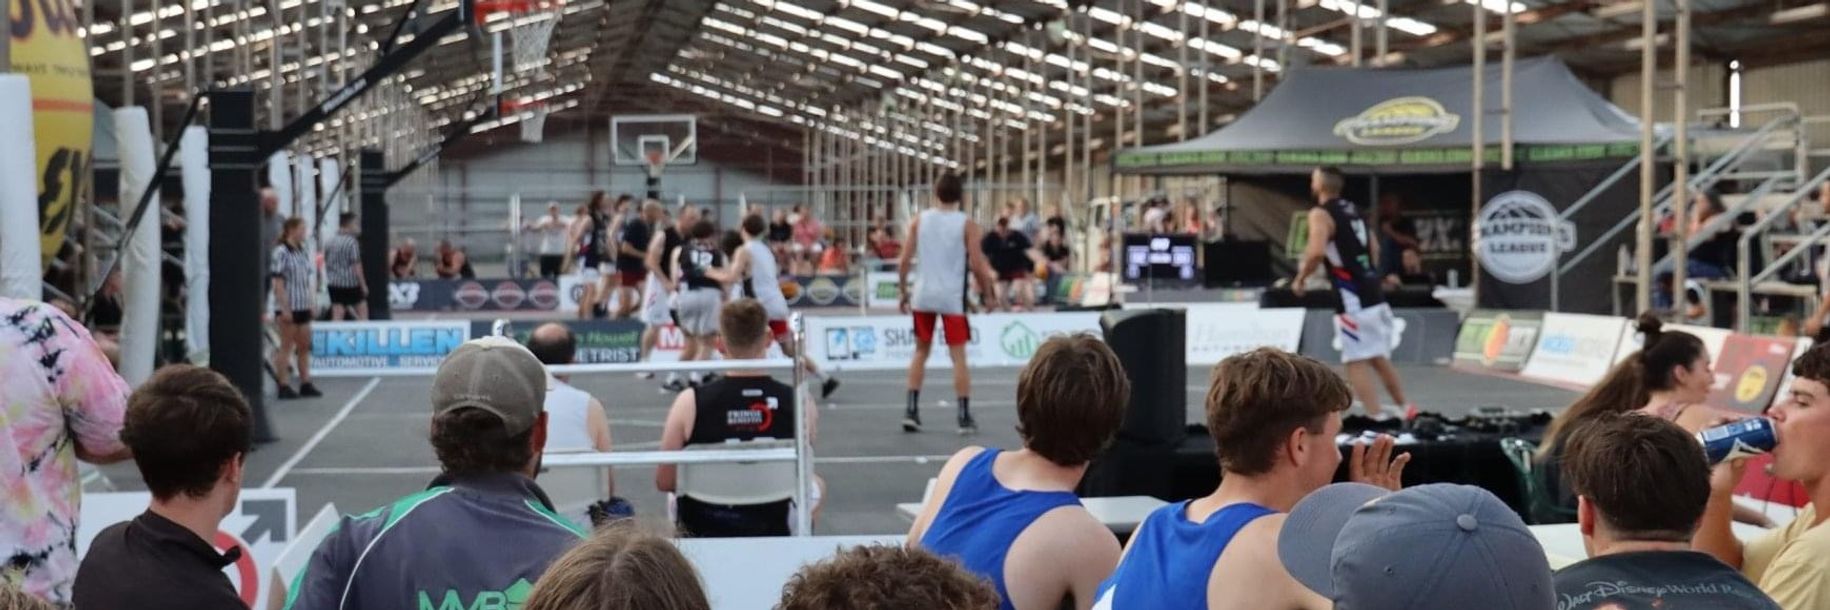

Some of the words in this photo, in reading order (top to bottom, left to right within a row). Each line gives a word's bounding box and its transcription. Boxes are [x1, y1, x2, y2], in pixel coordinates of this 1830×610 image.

[1488, 243, 1546, 254] LEAGUE
[327, 328, 460, 356] KILLEN
[575, 347, 640, 361] ETRIST
[312, 356, 387, 368] AUTOMOTIVE
[1666, 583, 1718, 594] World
